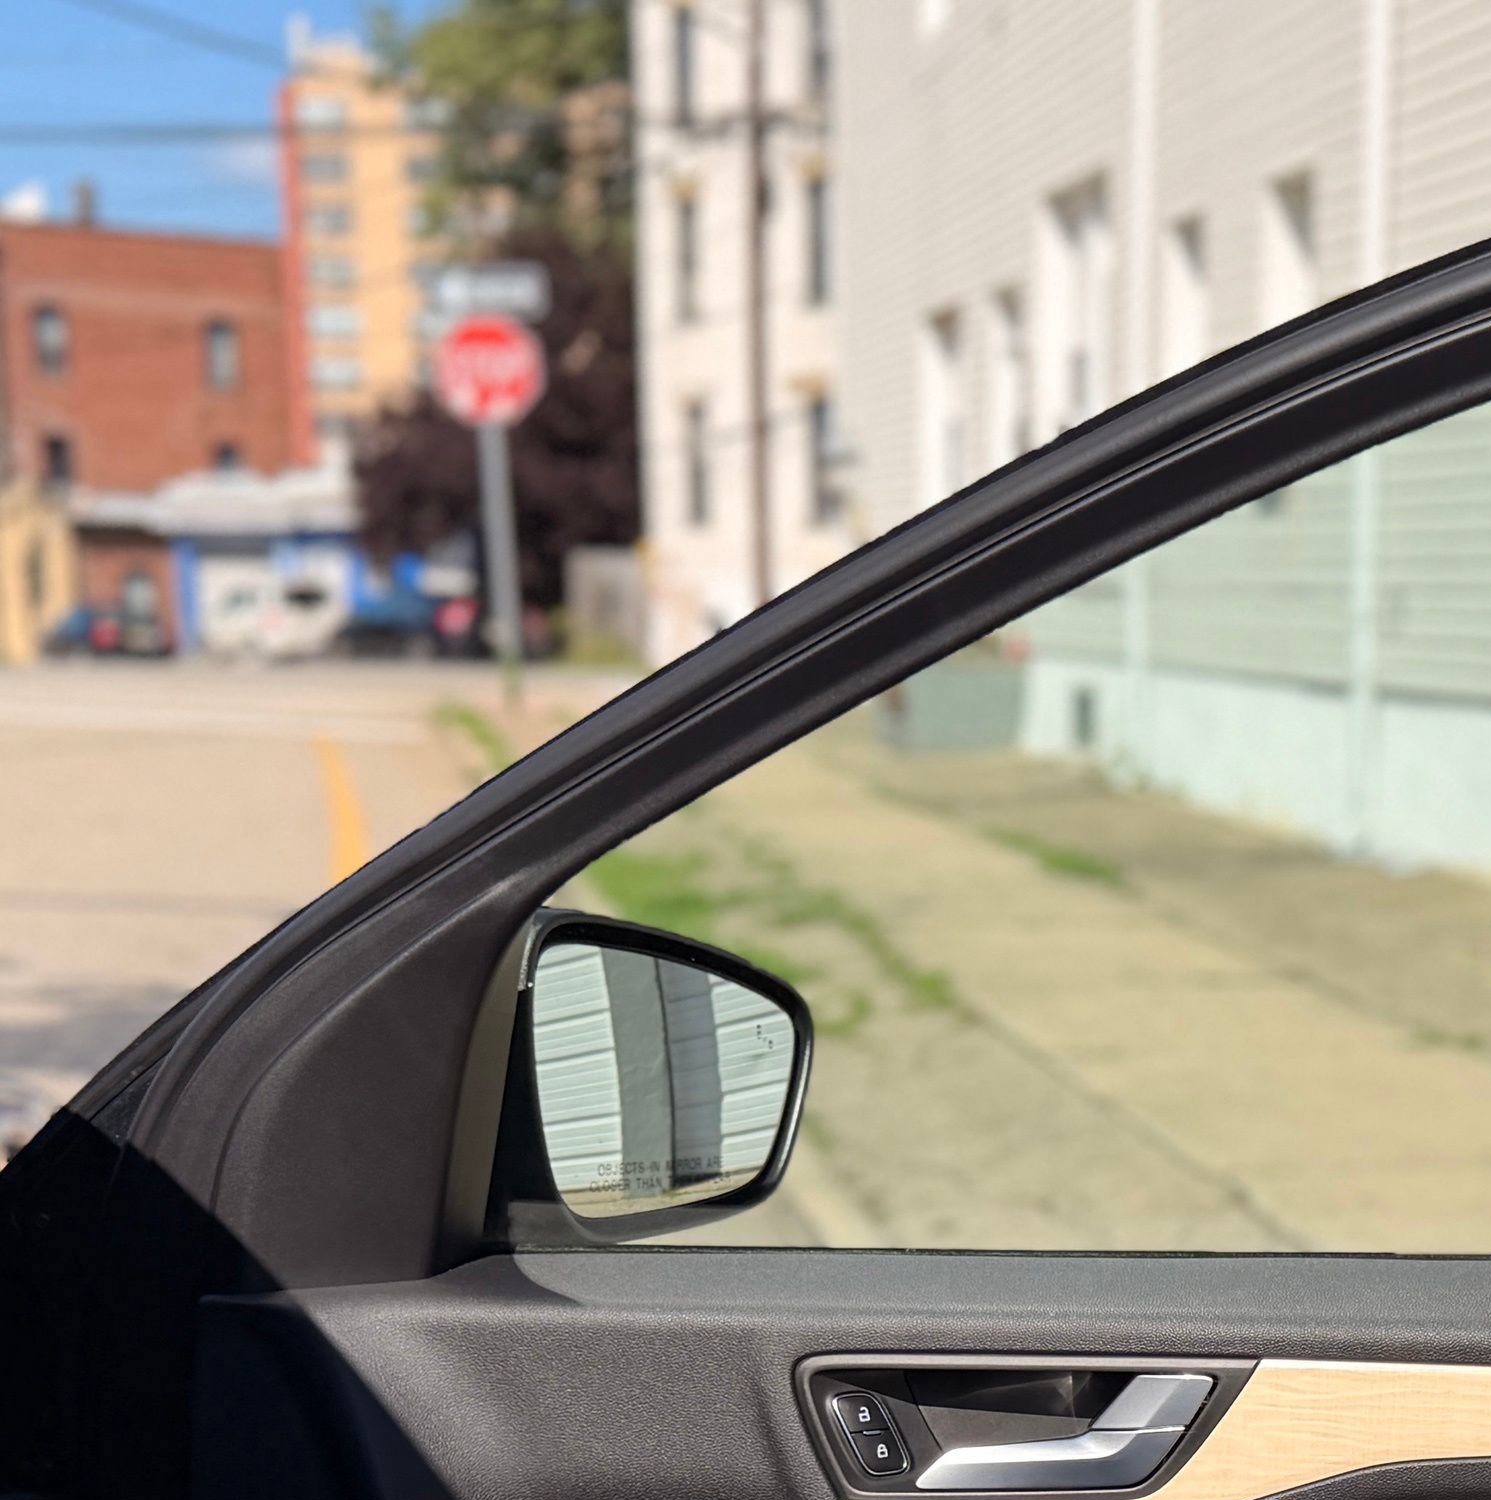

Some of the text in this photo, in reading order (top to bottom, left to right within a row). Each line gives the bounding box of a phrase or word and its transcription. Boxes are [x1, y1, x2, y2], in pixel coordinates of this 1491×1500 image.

[598, 1160, 645, 1176] OBJECTS
[666, 1157, 701, 1171] MRROR
[590, 1179, 630, 1192] CLOSER
[636, 1176, 664, 1190] THAN
